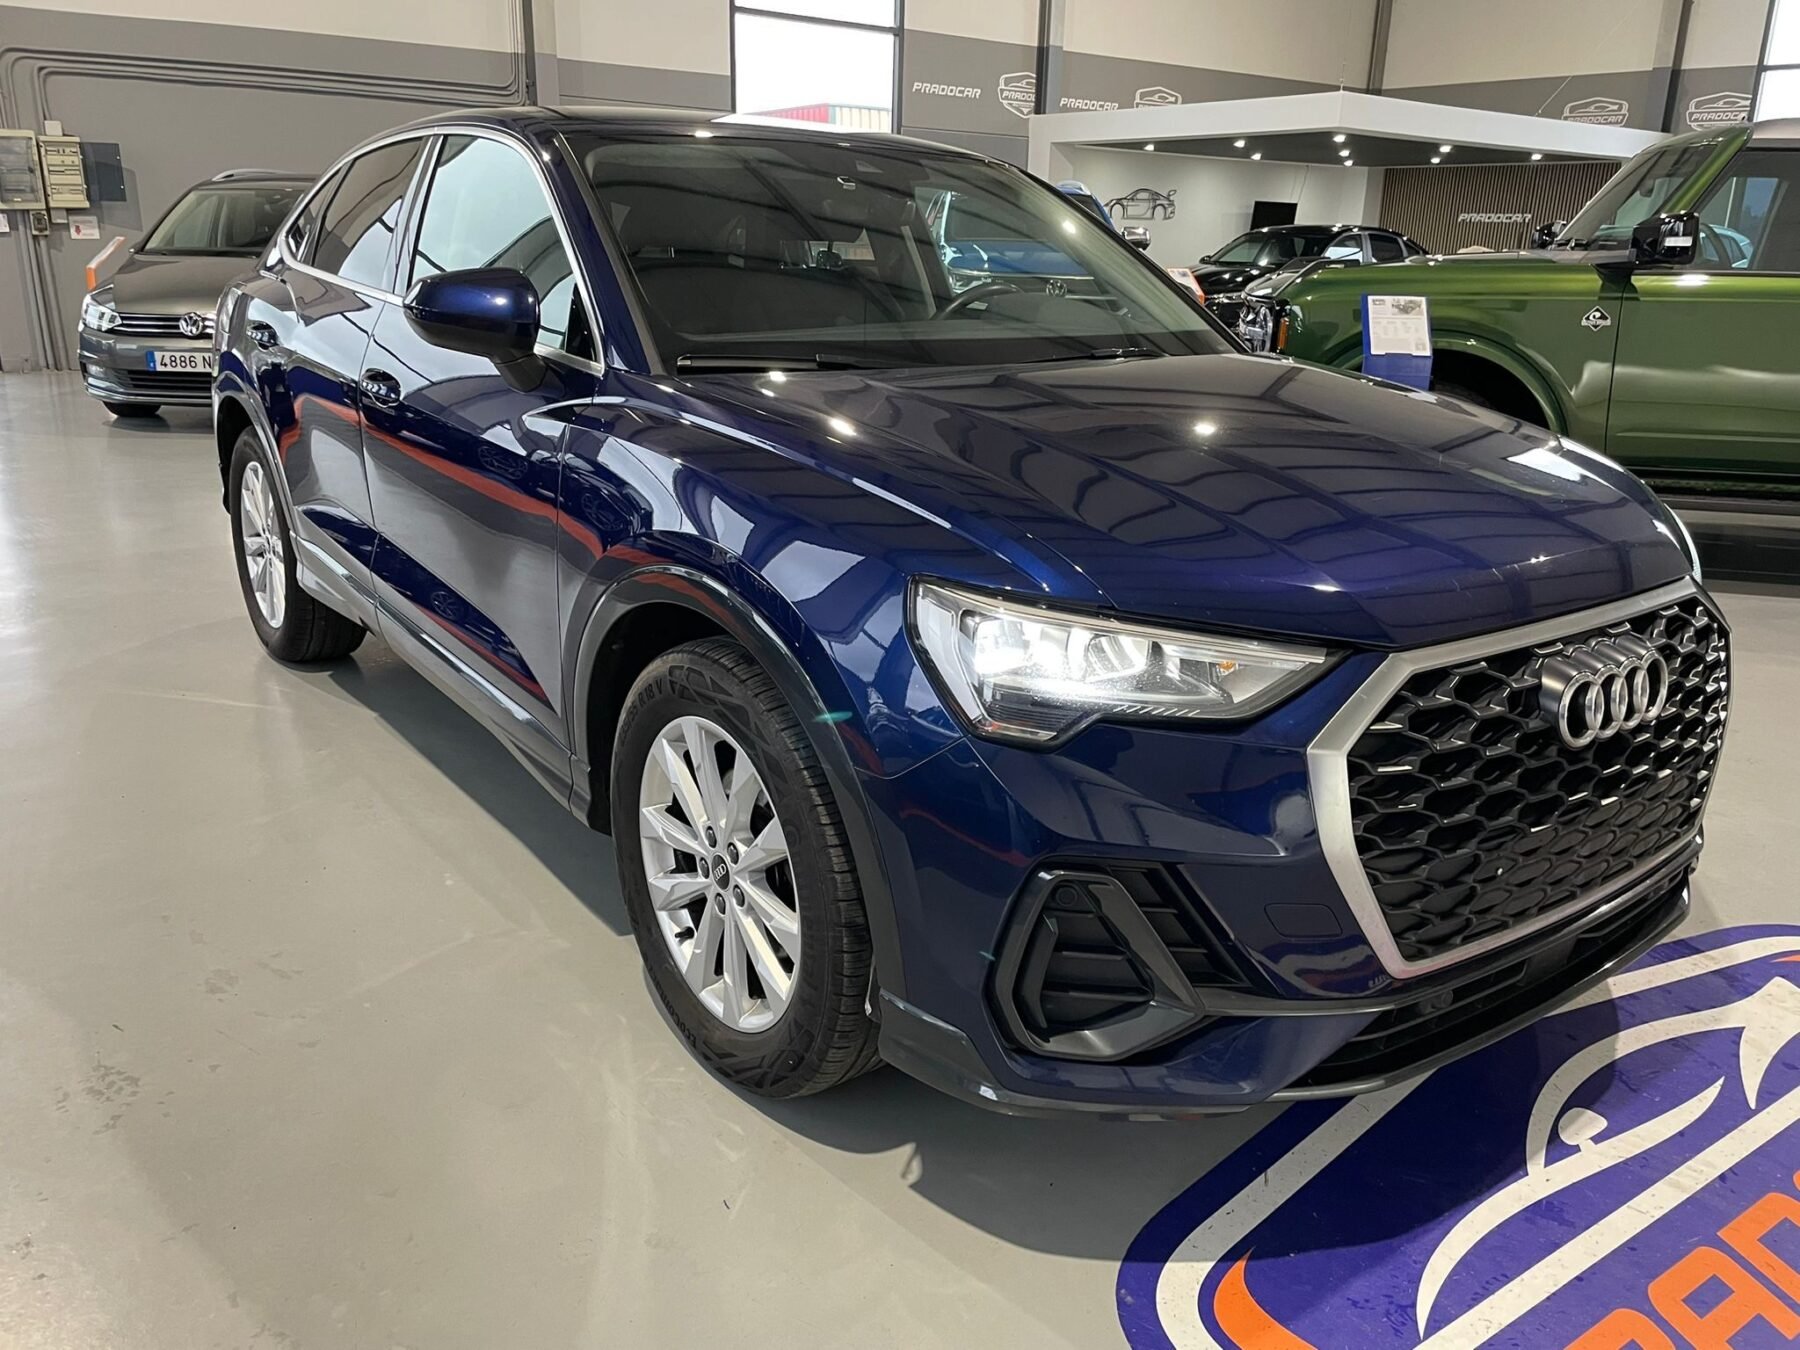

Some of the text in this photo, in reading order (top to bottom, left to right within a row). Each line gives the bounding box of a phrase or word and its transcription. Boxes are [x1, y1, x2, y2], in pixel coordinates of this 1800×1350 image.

[912, 82, 981, 99] PRADOCAR
[1060, 97, 1119, 111] PRADOCAR
[1458, 213, 1532, 223] PRADOCAR
[160, 354, 198, 368] 4886
